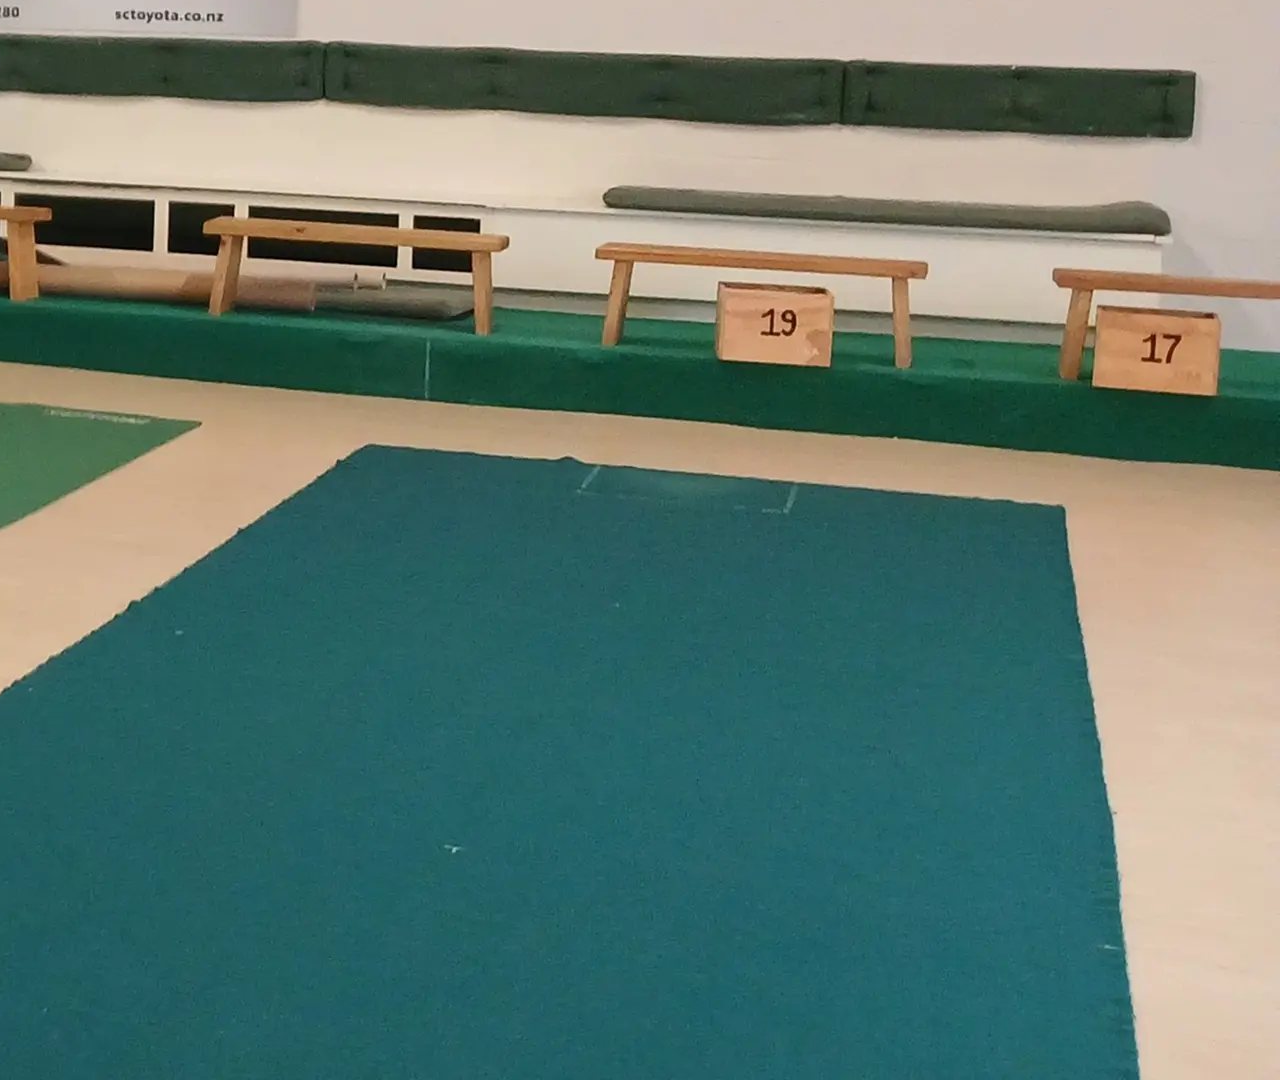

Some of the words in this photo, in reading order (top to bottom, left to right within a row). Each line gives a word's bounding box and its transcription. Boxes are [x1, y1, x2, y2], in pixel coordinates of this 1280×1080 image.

[115, 9, 224, 23] sctoyota.co.nz
[759, 308, 798, 337] 19
[1140, 334, 1183, 365] 17
